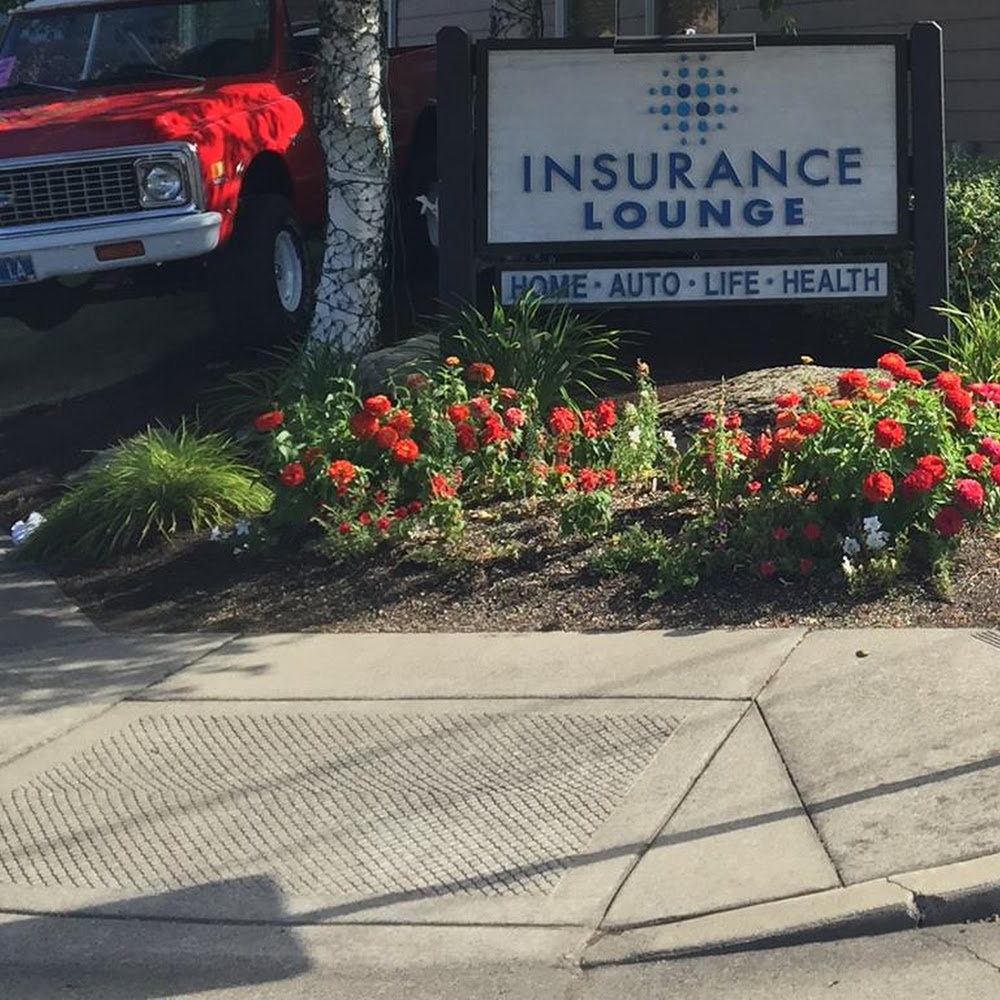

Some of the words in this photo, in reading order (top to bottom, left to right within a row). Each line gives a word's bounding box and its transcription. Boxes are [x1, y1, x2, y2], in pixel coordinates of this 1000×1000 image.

[522, 147, 863, 193] INSURANCE
[583, 197, 805, 231] LOUNGE
[510, 273, 588, 300] HOME
[608, 272, 682, 298] AUTO
[704, 270, 761, 297] LIFE
[782, 267, 881, 295] HEALTH
